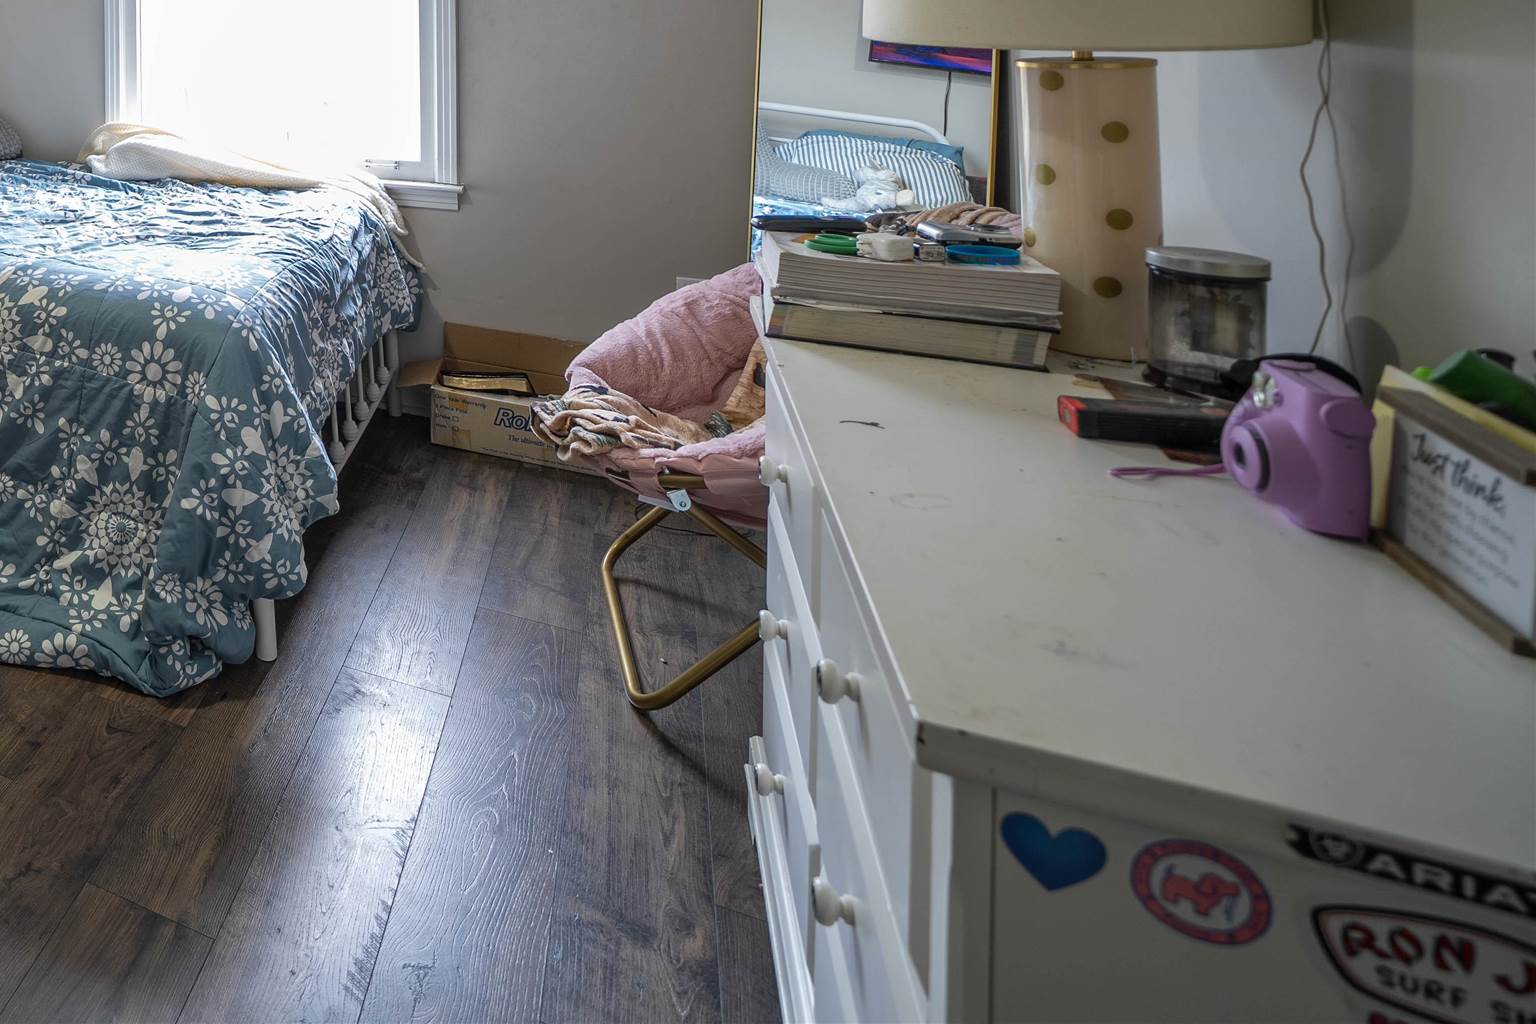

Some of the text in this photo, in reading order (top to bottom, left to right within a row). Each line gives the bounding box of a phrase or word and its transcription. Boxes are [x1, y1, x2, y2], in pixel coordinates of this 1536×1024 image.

[508, 434, 520, 443] The
[1412, 433, 1449, 481] Just
[1341, 921, 1476, 976] RON
[1375, 963, 1468, 1009] SURF
